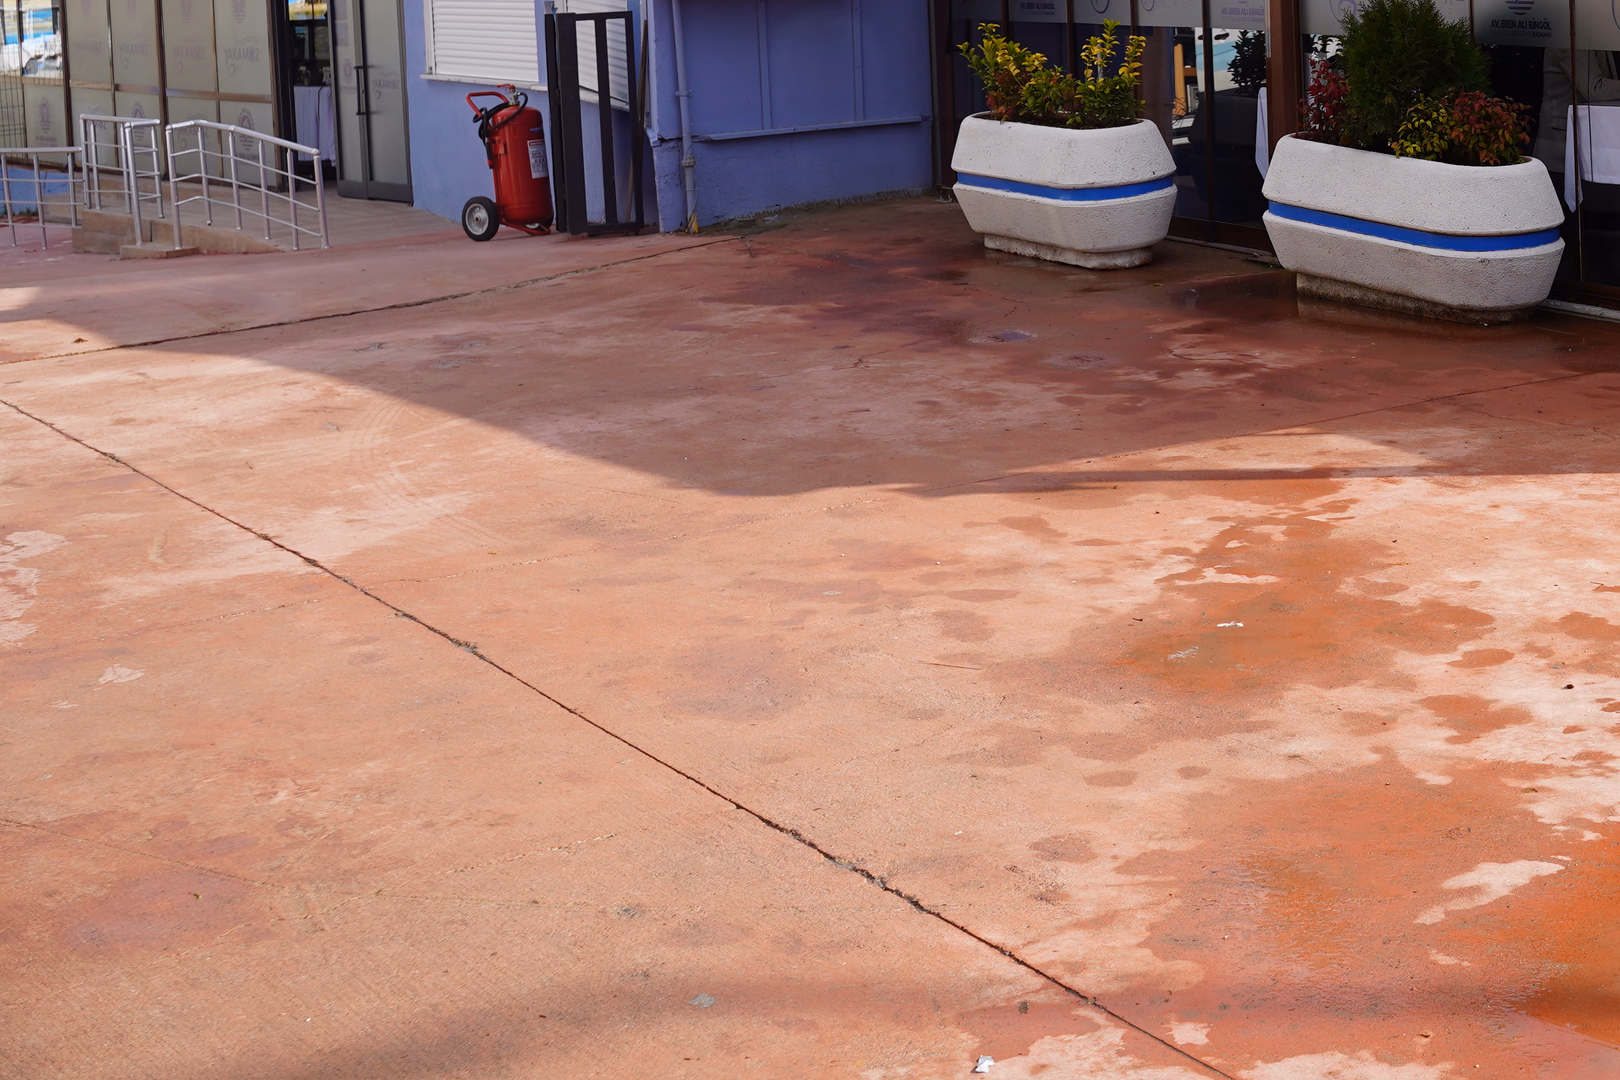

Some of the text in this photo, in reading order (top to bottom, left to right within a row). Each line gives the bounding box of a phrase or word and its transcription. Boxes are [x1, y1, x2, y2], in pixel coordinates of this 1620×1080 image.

[1490, 17, 1552, 30] AV. EREN ALİ BİNGÖL
[223, 45, 261, 77] YAKAMOZ
